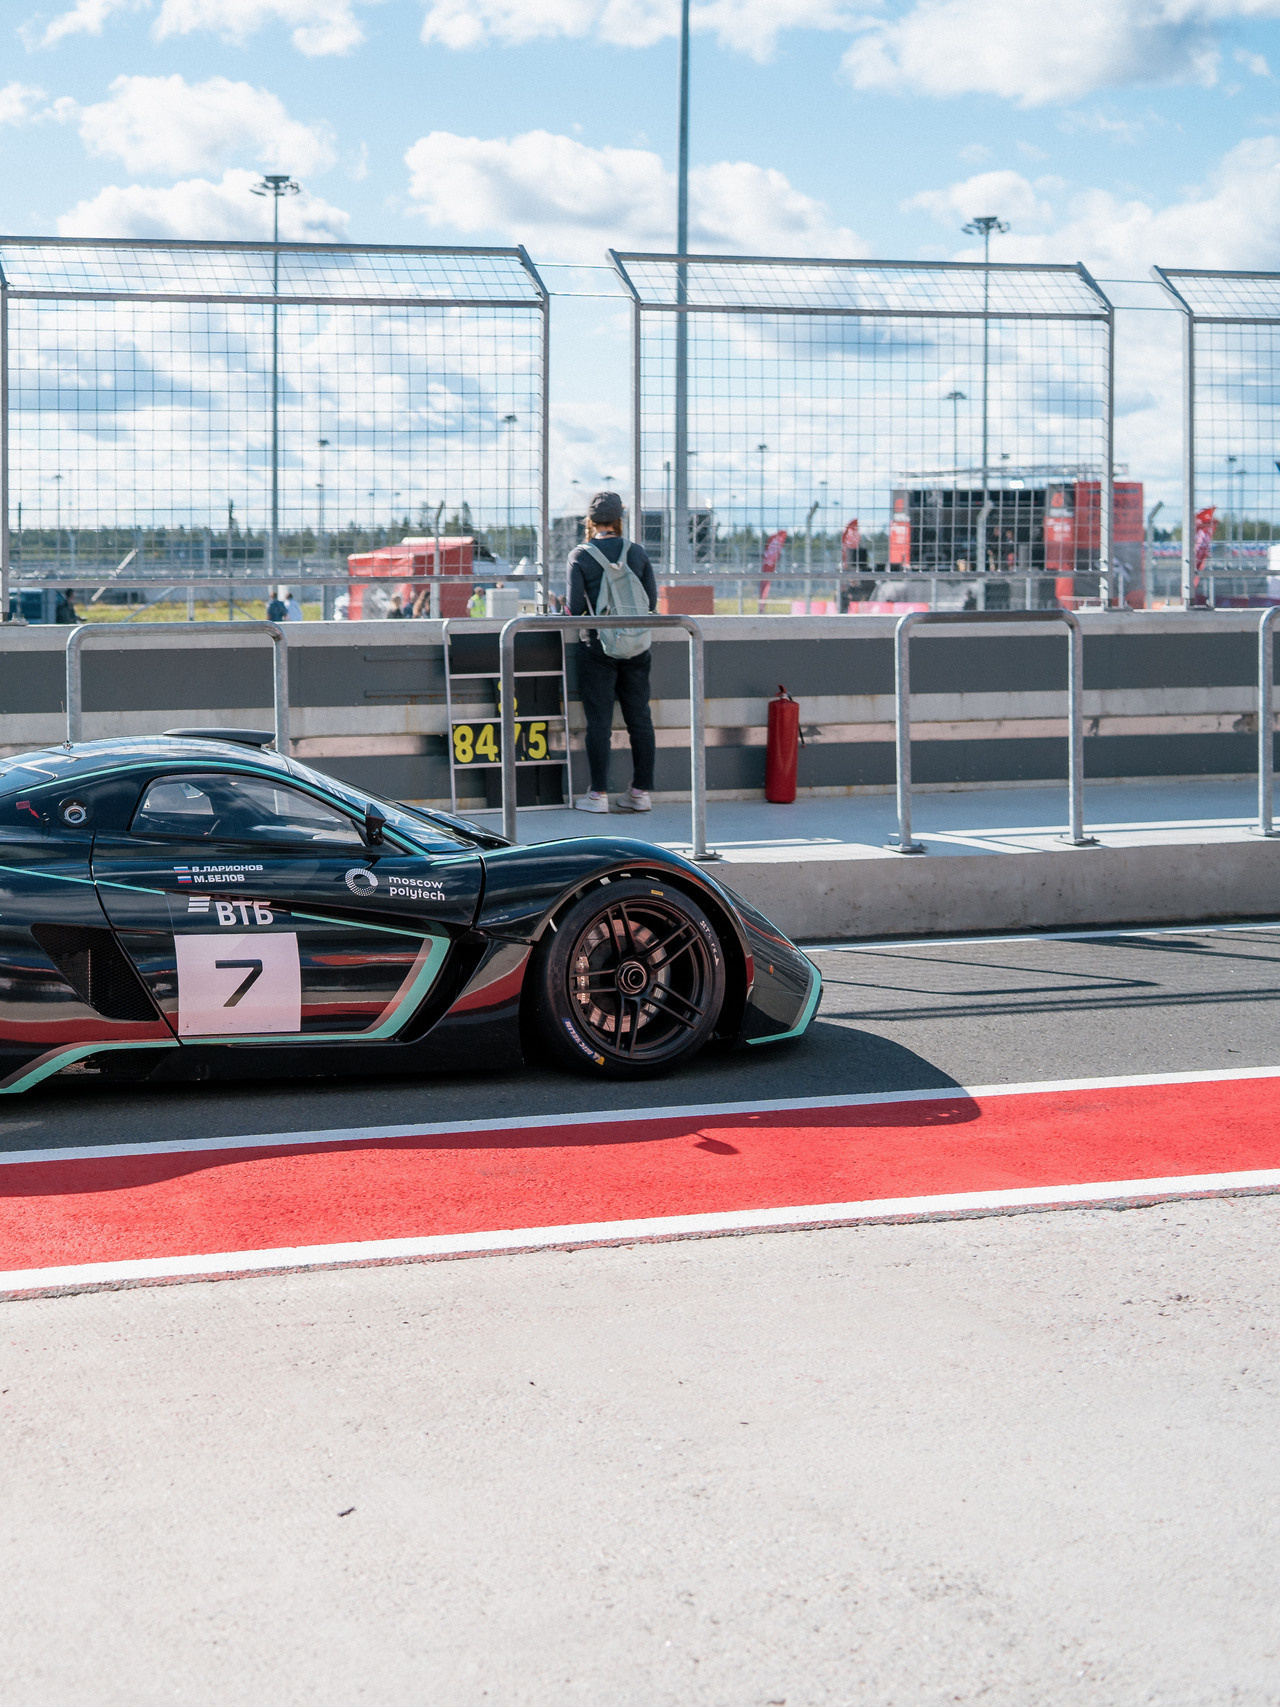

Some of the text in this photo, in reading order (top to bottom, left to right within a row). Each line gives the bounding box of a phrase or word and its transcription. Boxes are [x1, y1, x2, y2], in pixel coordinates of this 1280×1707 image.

[192, 864, 264, 873] В.ЛАРИОНОВ
[193, 874, 245, 883] М.БЕЛОВ
[388, 876, 443, 889] moscow
[389, 886, 445, 901] polytech
[214, 900, 274, 926] ВТБ
[215, 959, 263, 1008] 7
